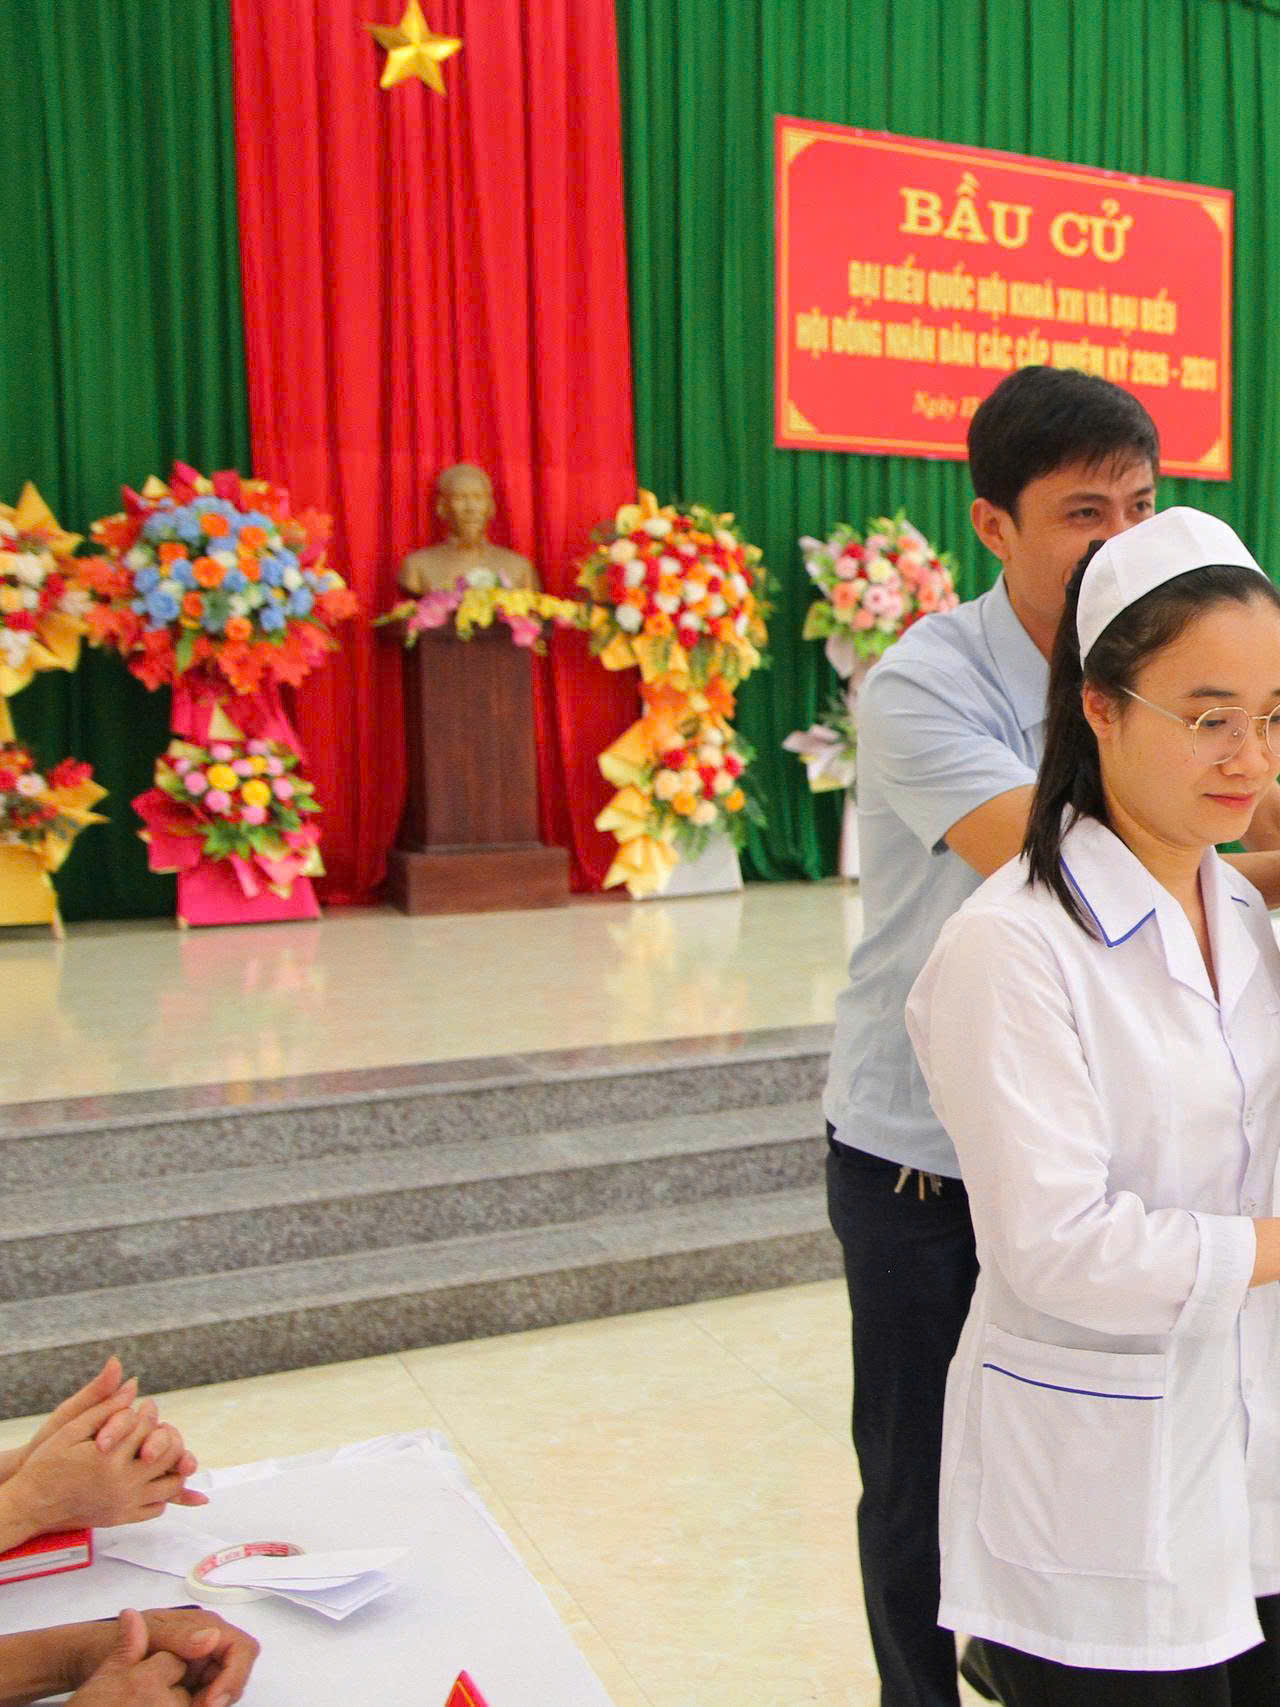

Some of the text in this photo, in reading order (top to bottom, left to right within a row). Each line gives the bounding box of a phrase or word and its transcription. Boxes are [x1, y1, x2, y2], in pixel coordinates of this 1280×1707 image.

[899, 171, 1133, 263] BẦU CỬ
[928, 261, 974, 310] QUỐC
[796, 306, 829, 359] HỘI
[832, 306, 882, 357] ĐỒNG
[885, 317, 935, 361] NHÂN
[938, 321, 976, 366] DÂN
[978, 328, 1013, 370] CÁC
